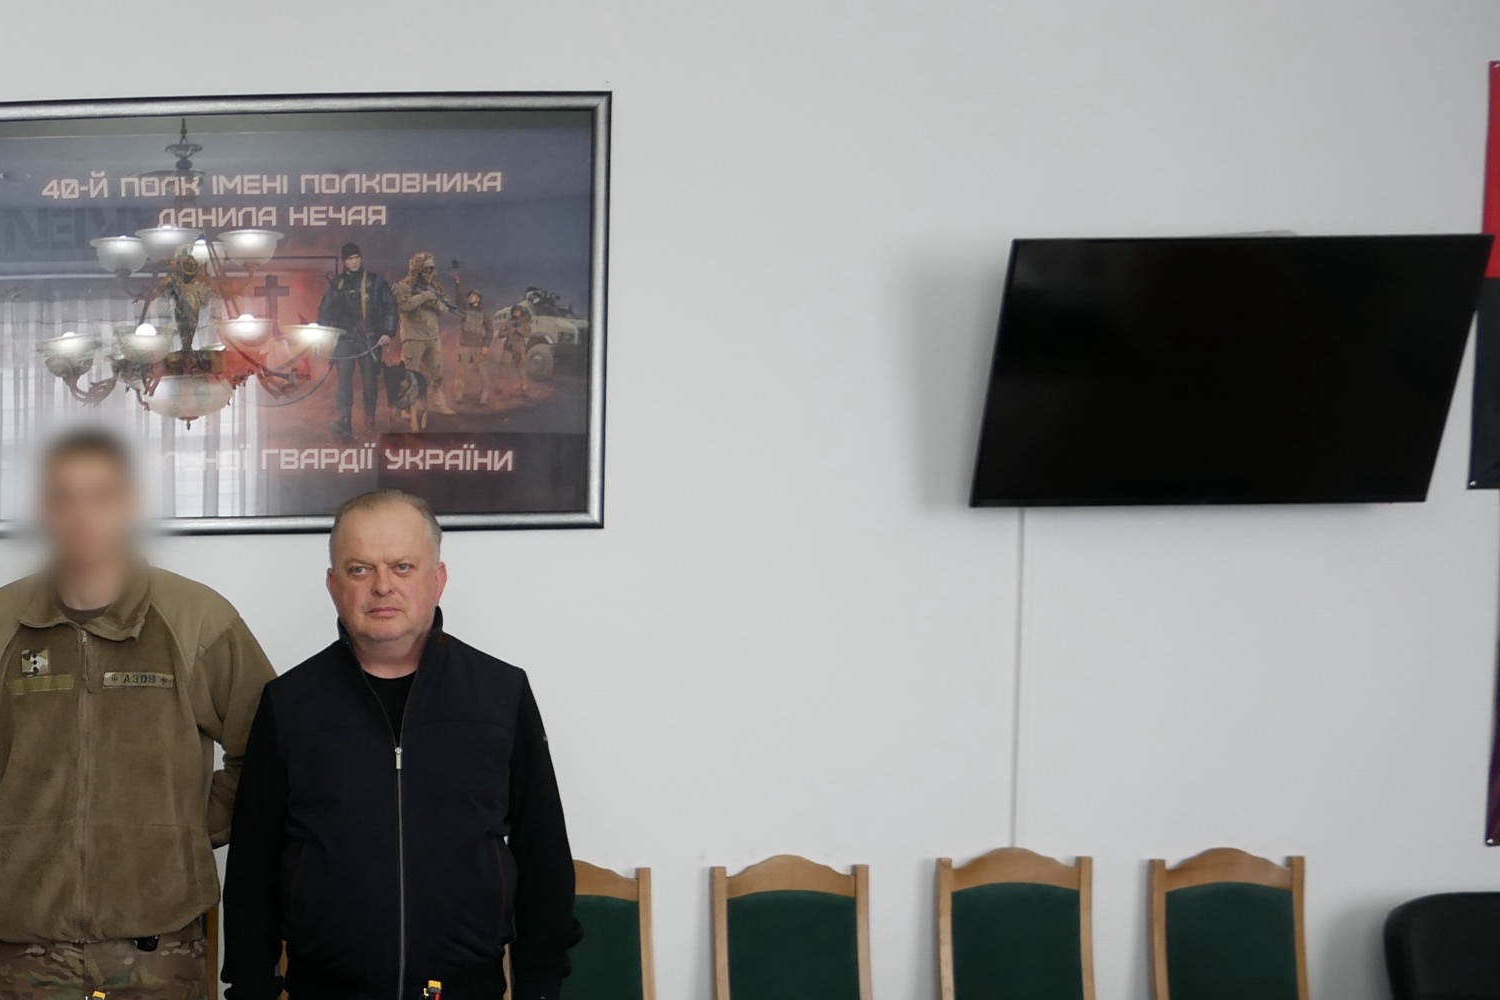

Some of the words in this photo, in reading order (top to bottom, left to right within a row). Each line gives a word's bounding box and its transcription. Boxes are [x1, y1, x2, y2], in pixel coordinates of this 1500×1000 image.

[41, 170, 108, 199] 40-Й
[120, 176, 200, 198] ПОЛК
[212, 174, 288, 195] ІМЕНІ
[300, 172, 502, 194] ПОЛКОВНИКА
[158, 206, 277, 228] ДАНИЛА
[289, 205, 387, 226] НЕЧАЯ
[261, 443, 376, 473] ГВАРДІЇ
[385, 444, 513, 472] УКРАЇНИ
